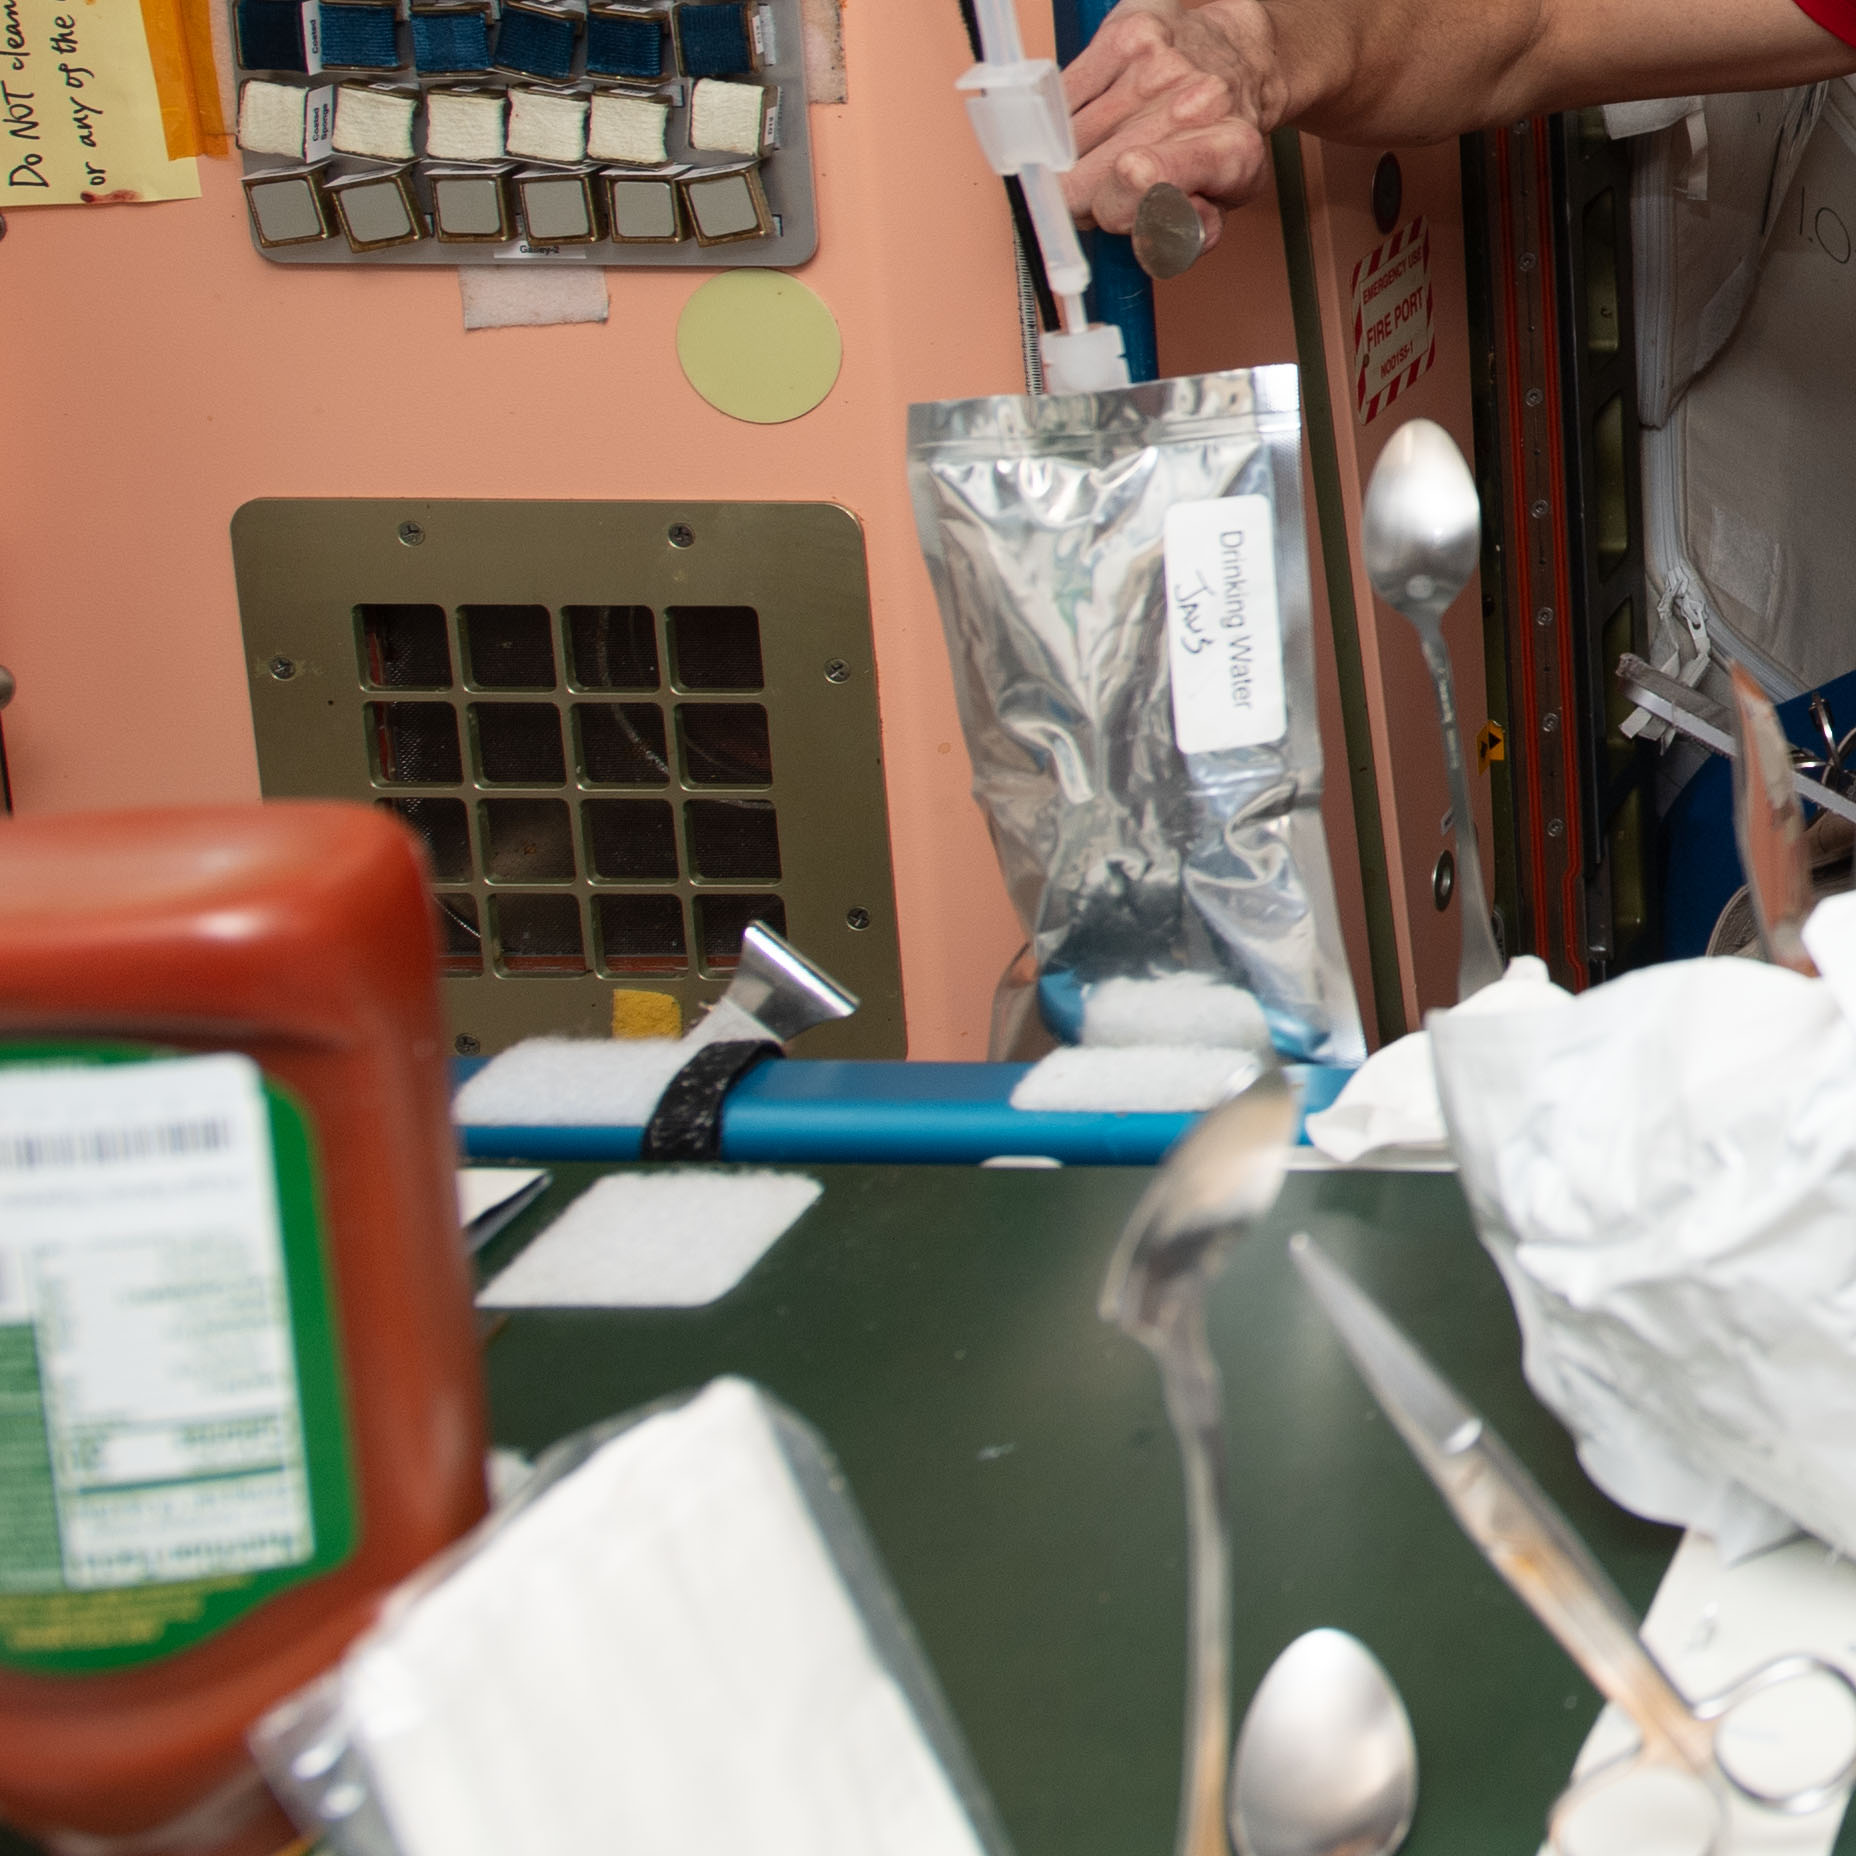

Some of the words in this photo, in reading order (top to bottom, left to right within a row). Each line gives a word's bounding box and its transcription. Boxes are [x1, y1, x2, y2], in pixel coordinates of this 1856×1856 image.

[50, 14, 78, 54] the
[309, 19, 318, 54] Coated
[58, 63, 94, 88] of
[2, 80, 39, 140] NOT
[71, 96, 102, 147] any
[312, 107, 320, 141] Coated
[320, 103, 330, 140] Sponge
[9, 153, 48, 187] Do
[84, 161, 105, 186] or
[1364, 261, 1406, 305] EMERGENCY
[1408, 250, 1422, 269] USE
[1367, 313, 1391, 352] FIRE
[1394, 286, 1423, 328] PORT
[1219, 530, 1247, 628] Drinking
[1229, 635, 1253, 709] Water
